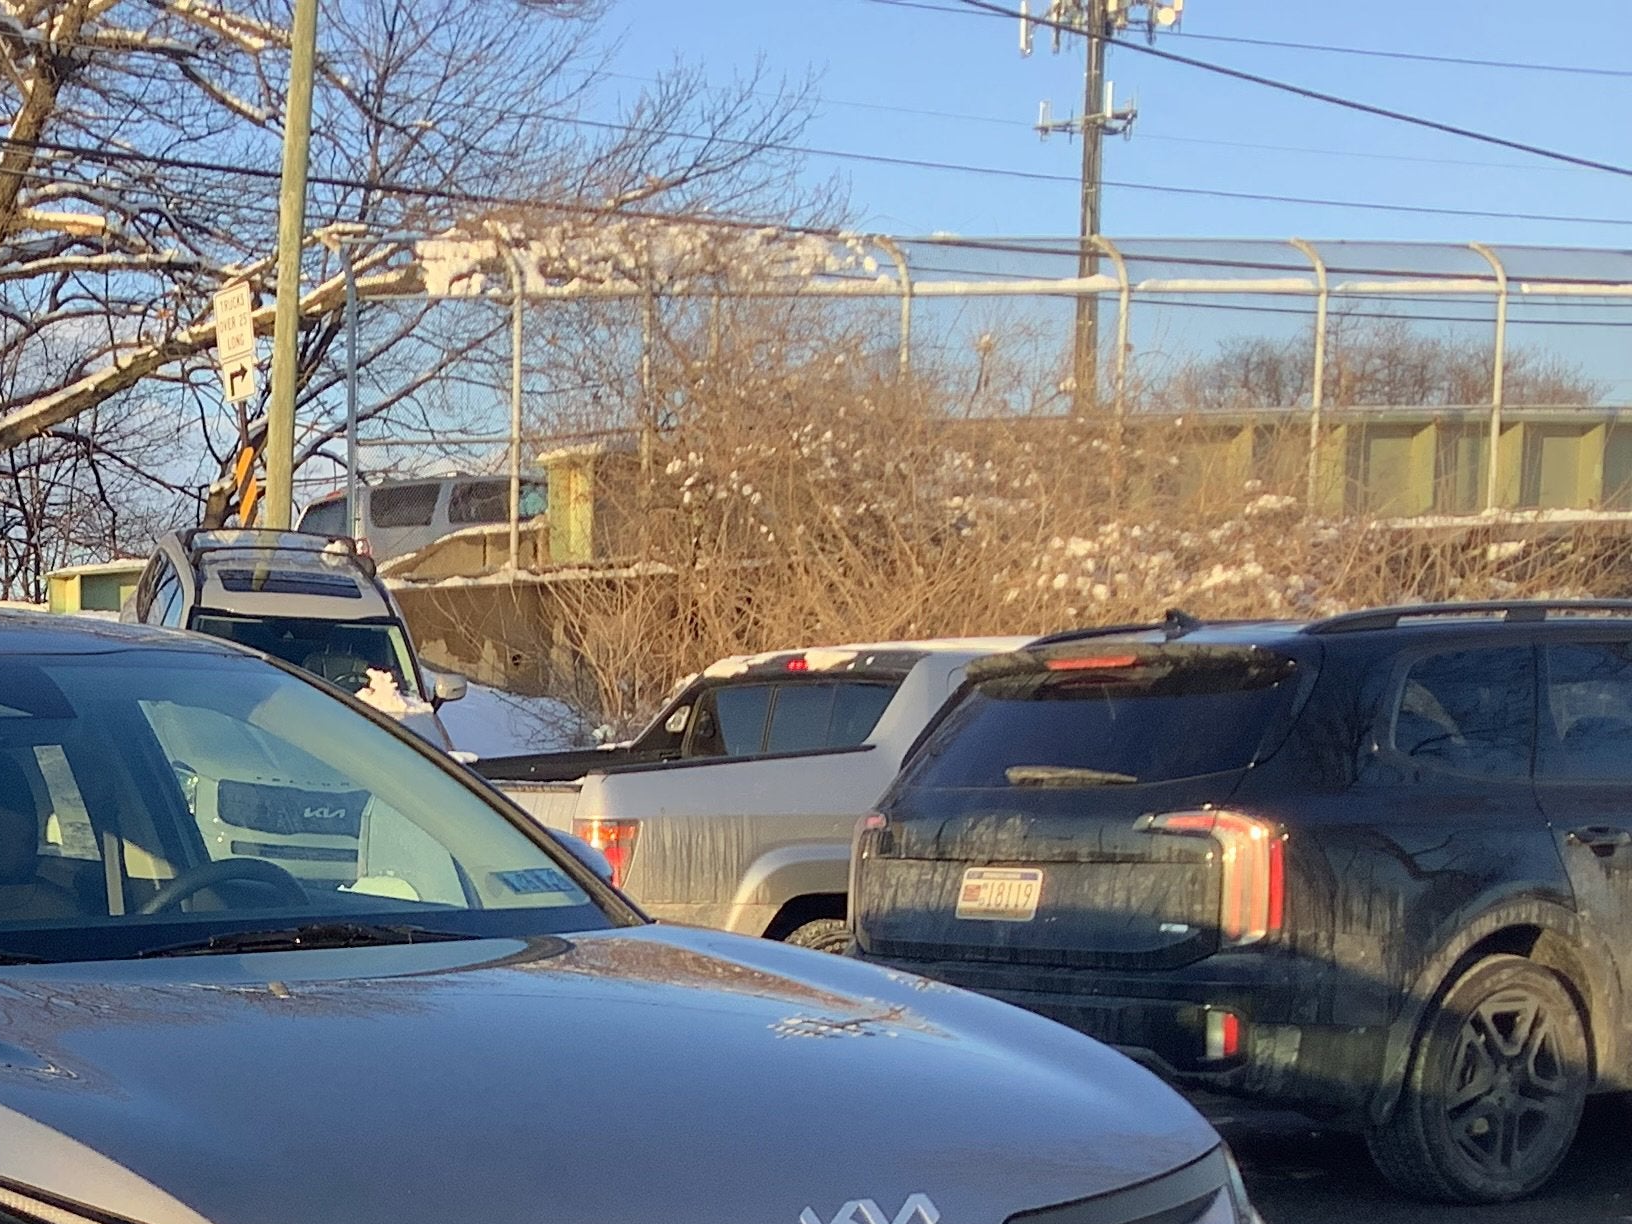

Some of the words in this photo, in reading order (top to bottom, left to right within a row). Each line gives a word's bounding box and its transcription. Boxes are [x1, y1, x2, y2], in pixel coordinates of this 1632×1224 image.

[220, 293, 245, 312] TRUCKS
[220, 316, 236, 333] OVER
[228, 333, 245, 350] LONG
[304, 806, 346, 819] KIA
